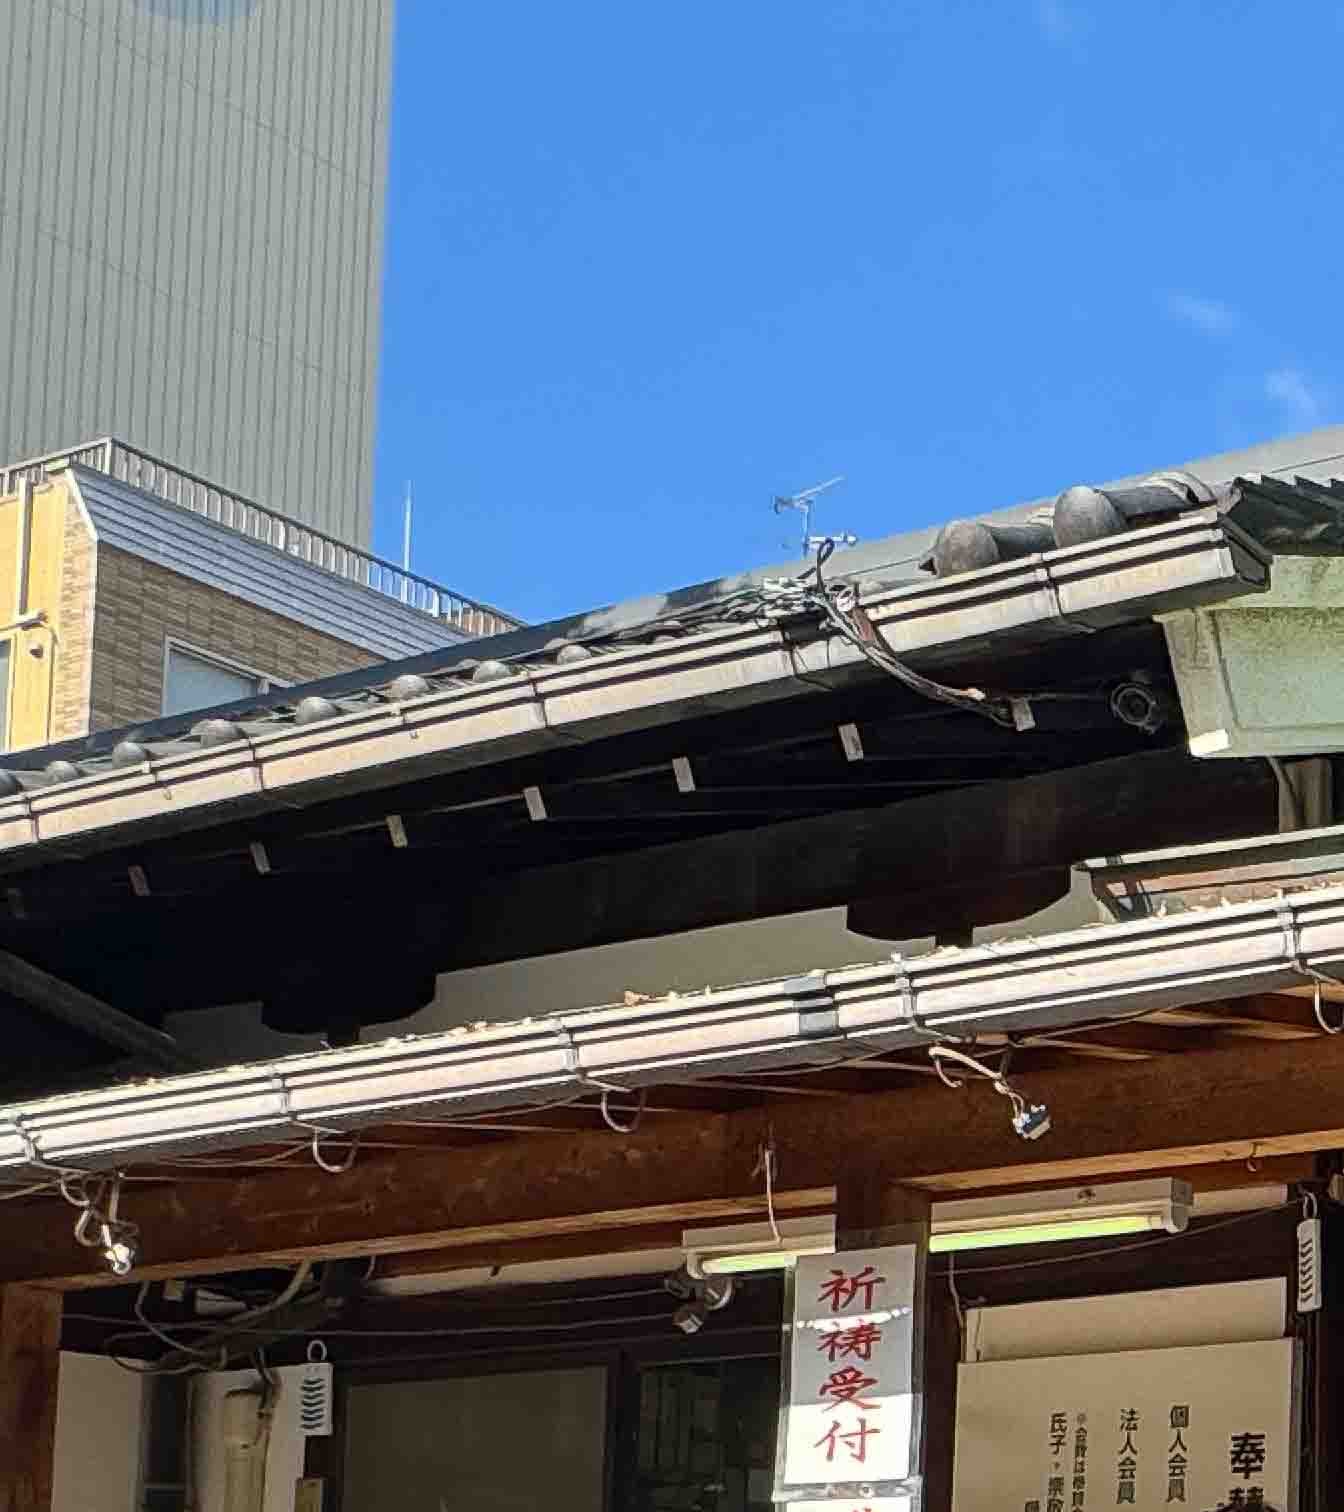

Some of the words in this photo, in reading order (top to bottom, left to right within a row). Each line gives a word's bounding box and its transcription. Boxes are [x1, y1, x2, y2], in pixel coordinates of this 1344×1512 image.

[813, 1265, 887, 1463] 祈祷受付
[1115, 1407, 1142, 1505] 法人会員
[1163, 1404, 1190, 1503] 個人会員
